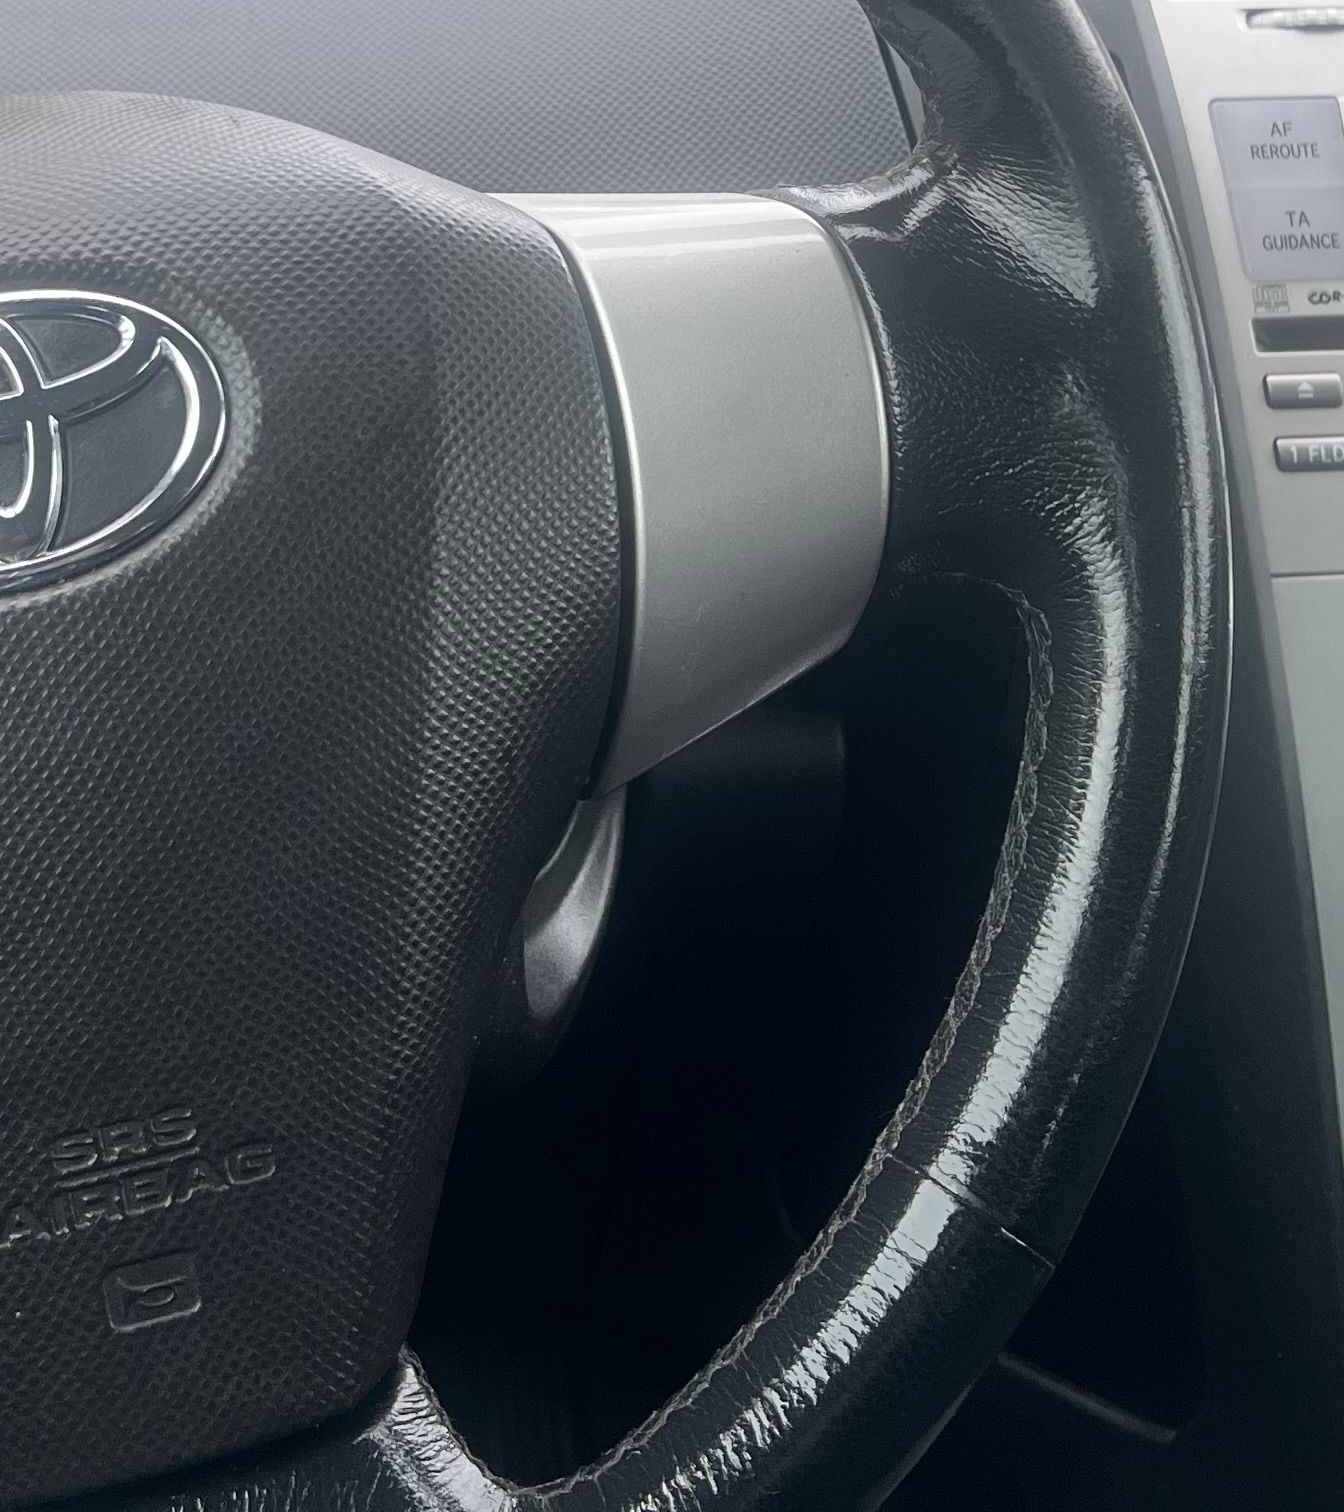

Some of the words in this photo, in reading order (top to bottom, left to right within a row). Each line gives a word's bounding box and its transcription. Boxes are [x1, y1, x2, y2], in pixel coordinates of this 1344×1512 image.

[1270, 121, 1293, 137] AF
[1250, 142, 1320, 160] REROUTE
[1284, 209, 1311, 228] TA
[1262, 232, 1340, 251] GUIDANCE
[1289, 445, 1299, 464] 1
[53, 1107, 199, 1175] SRS
